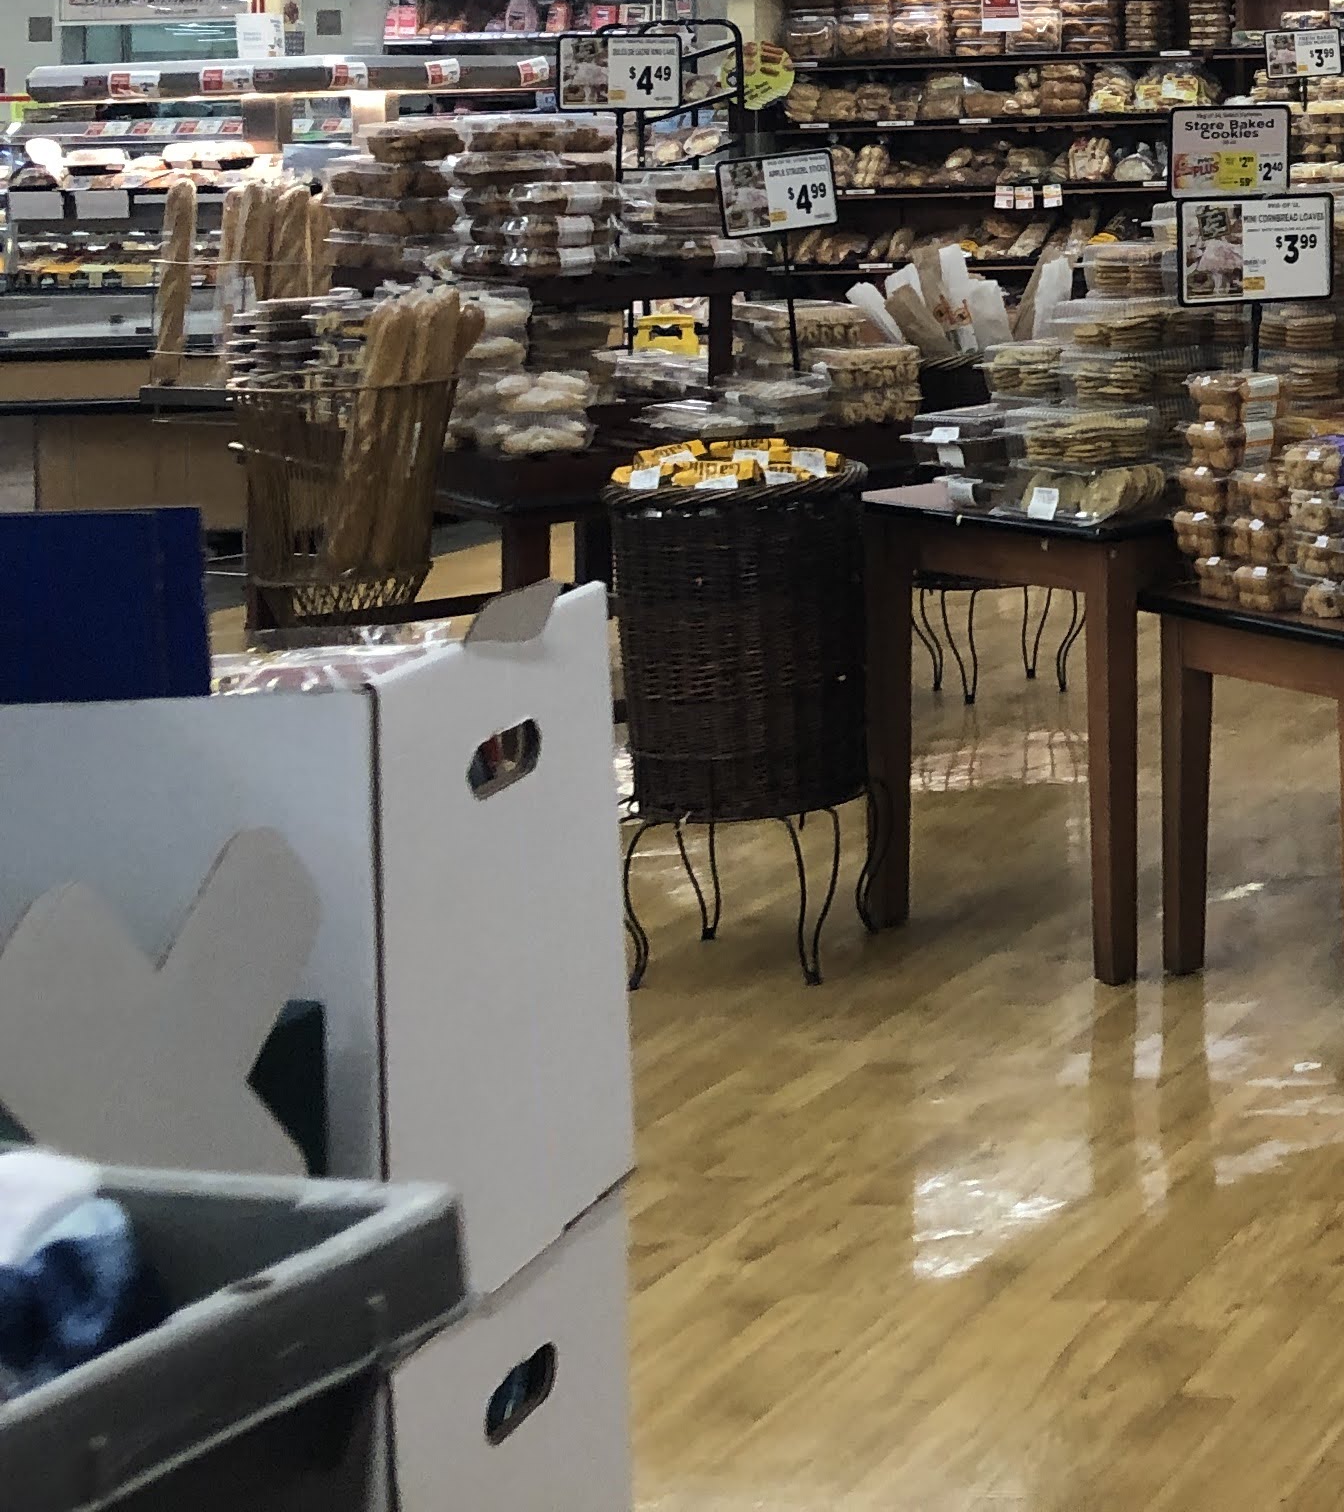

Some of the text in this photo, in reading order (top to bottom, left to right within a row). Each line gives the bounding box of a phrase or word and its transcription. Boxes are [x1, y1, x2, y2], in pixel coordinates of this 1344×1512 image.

[1184, 118, 1275, 131] Store Baked
[1200, 129, 1259, 140] Cookies
